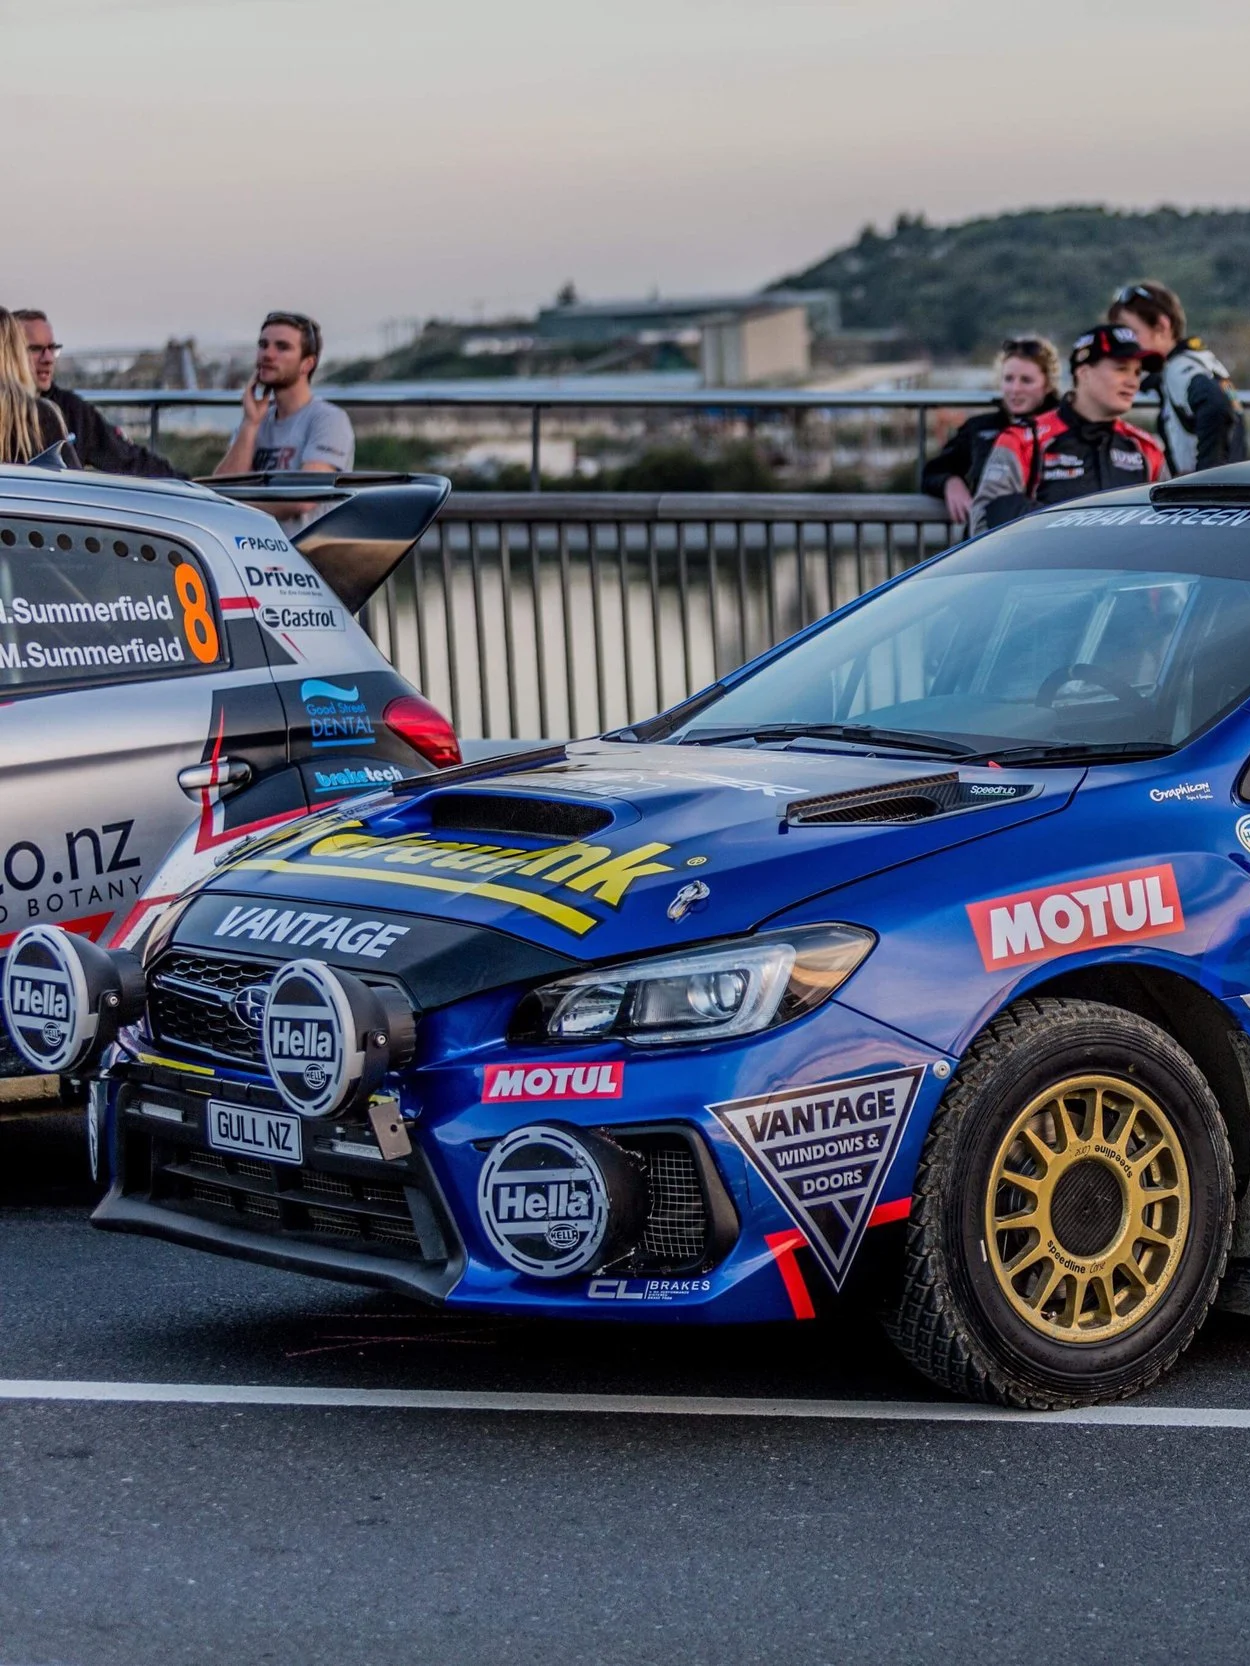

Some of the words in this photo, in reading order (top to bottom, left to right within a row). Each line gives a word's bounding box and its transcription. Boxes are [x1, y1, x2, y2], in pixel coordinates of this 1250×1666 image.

[1046, 509, 1150, 529] BRIAN
[248, 537, 289, 552] PAGID
[245, 566, 320, 589] Driven
[174, 562, 219, 664] 8
[281, 608, 337, 627] Castrol
[0, 636, 185, 669] M.Summerfield
[306, 702, 336, 716] Good
[337, 701, 367, 713] Street
[311, 716, 375, 737] DENTAL
[315, 766, 404, 787] braketech
[970, 785, 1016, 796] Speedhub
[0, 819, 141, 895] o.nz
[28, 875, 143, 917] BOTANY
[214, 906, 411, 958] VANTAGE
[990, 876, 1174, 960] MOTUL
[14, 979, 67, 1019] Hella
[272, 1020, 332, 1058] Hella
[489, 1066, 618, 1097] MOTUL
[218, 1110, 265, 1147] GULL
[268, 1119, 293, 1152] NZ
[746, 1088, 897, 1143] VANTAGE
[776, 1136, 864, 1168] WINDOWS
[866, 1133, 880, 1149] &
[1094, 1144, 1133, 1179] speedline
[803, 1167, 864, 1195] DOORS
[499, 1184, 589, 1220] Hella
[1047, 1240, 1086, 1274] speedline
[588, 1280, 644, 1299] CL
[650, 1281, 711, 1291] BRAKES
